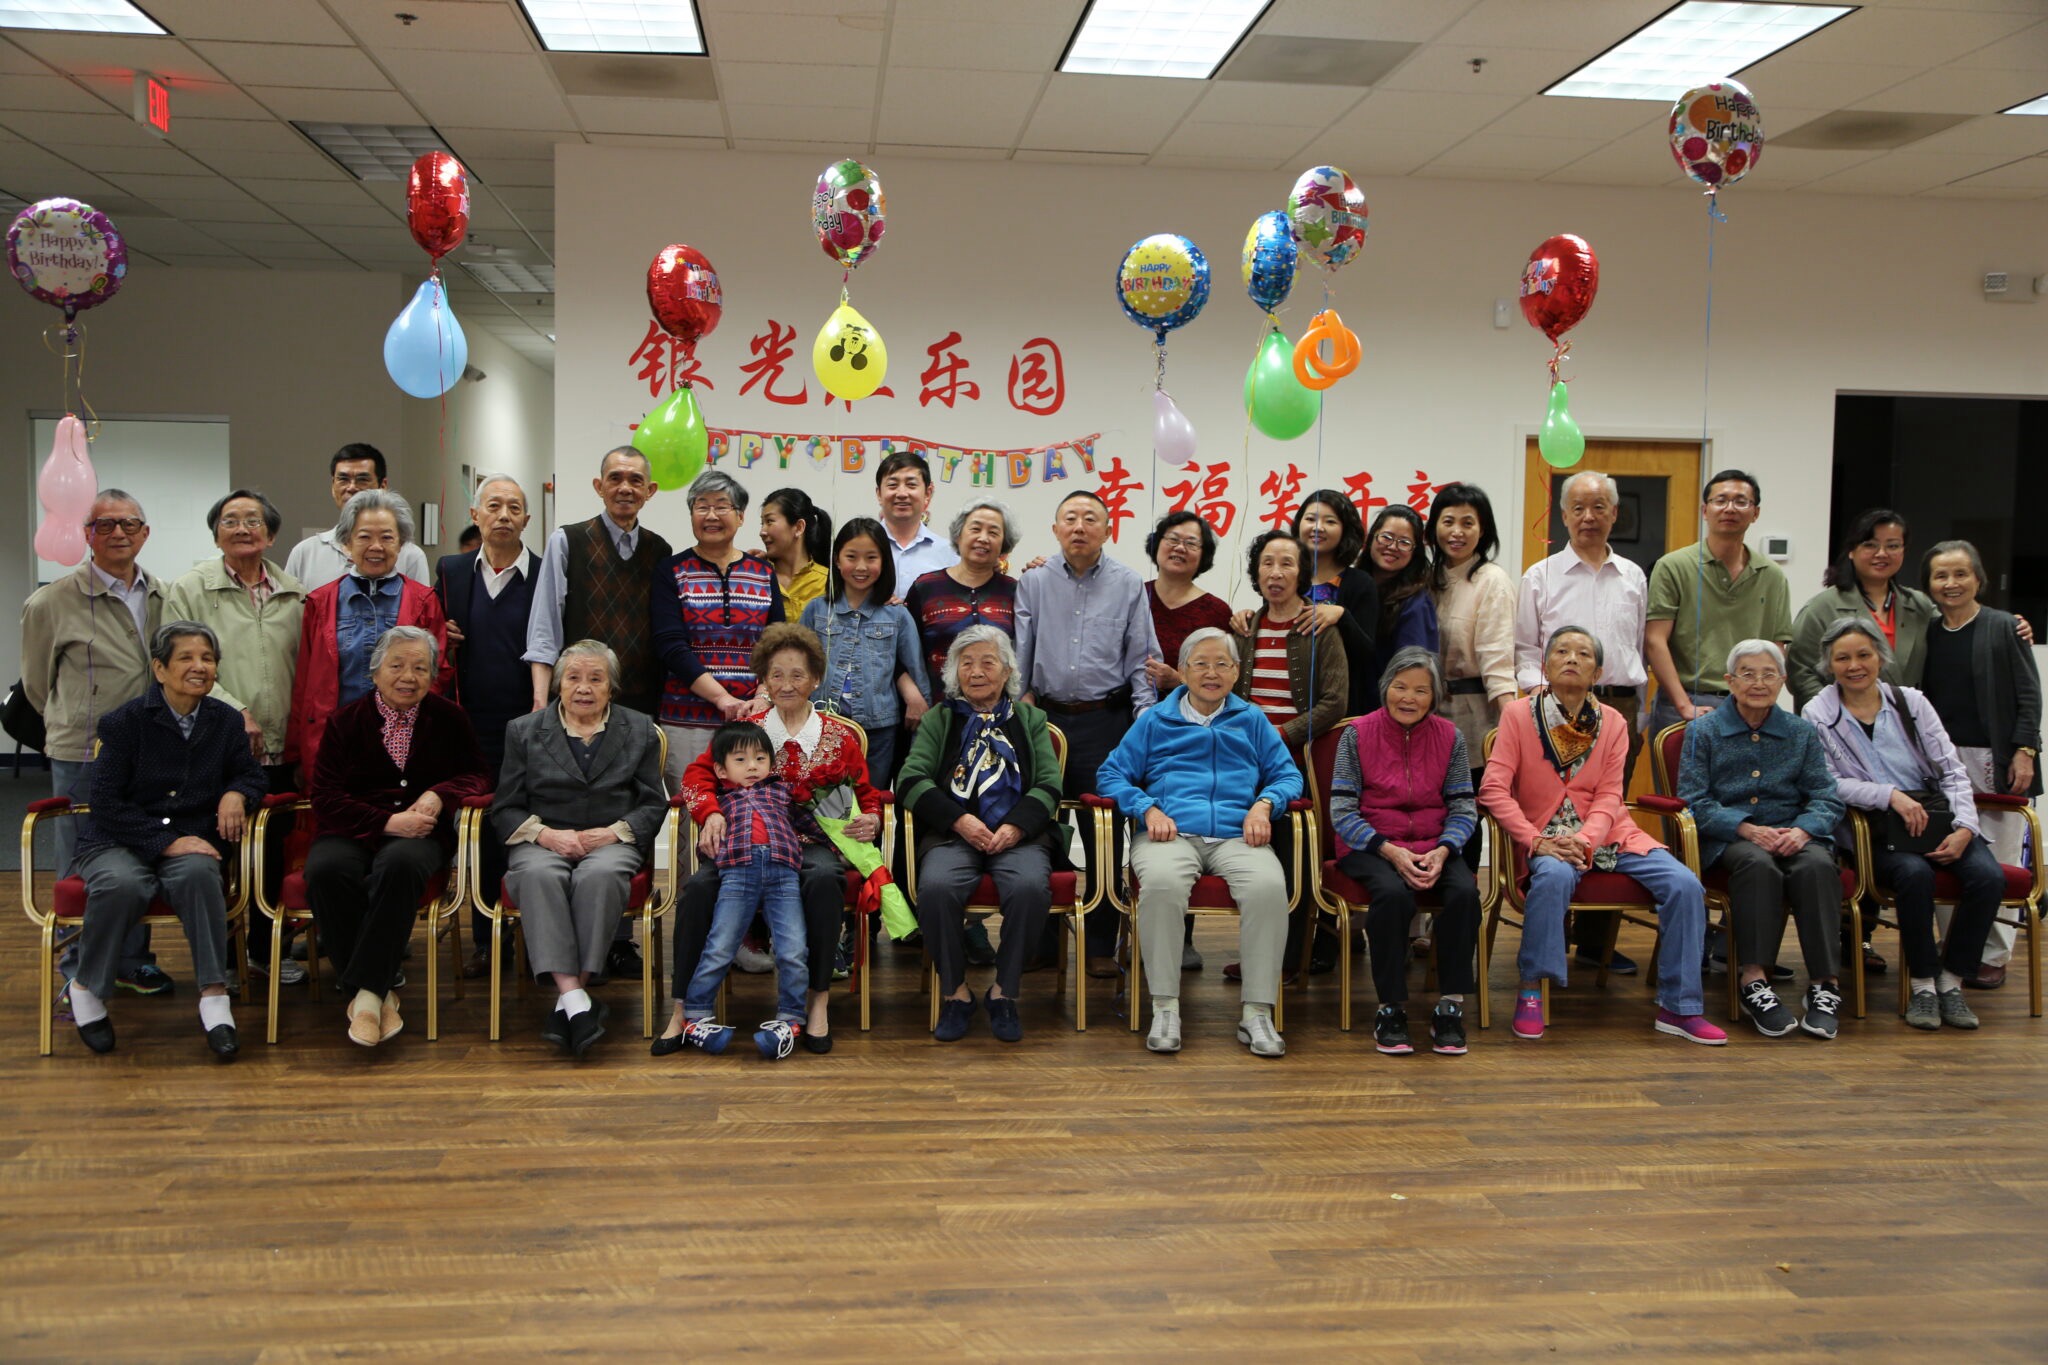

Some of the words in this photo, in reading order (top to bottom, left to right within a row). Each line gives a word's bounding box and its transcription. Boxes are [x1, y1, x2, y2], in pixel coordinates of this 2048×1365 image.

[1715, 96, 1760, 123] Happ
[41, 233, 88, 250] Happy
[29, 251, 99, 271] Birthday!
[1140, 263, 1172, 273] HAPPY
[1124, 276, 1191, 292] BIRTHDAY
[628, 318, 1065, 416] 银光乐园
[704, 429, 798, 469] PPY
